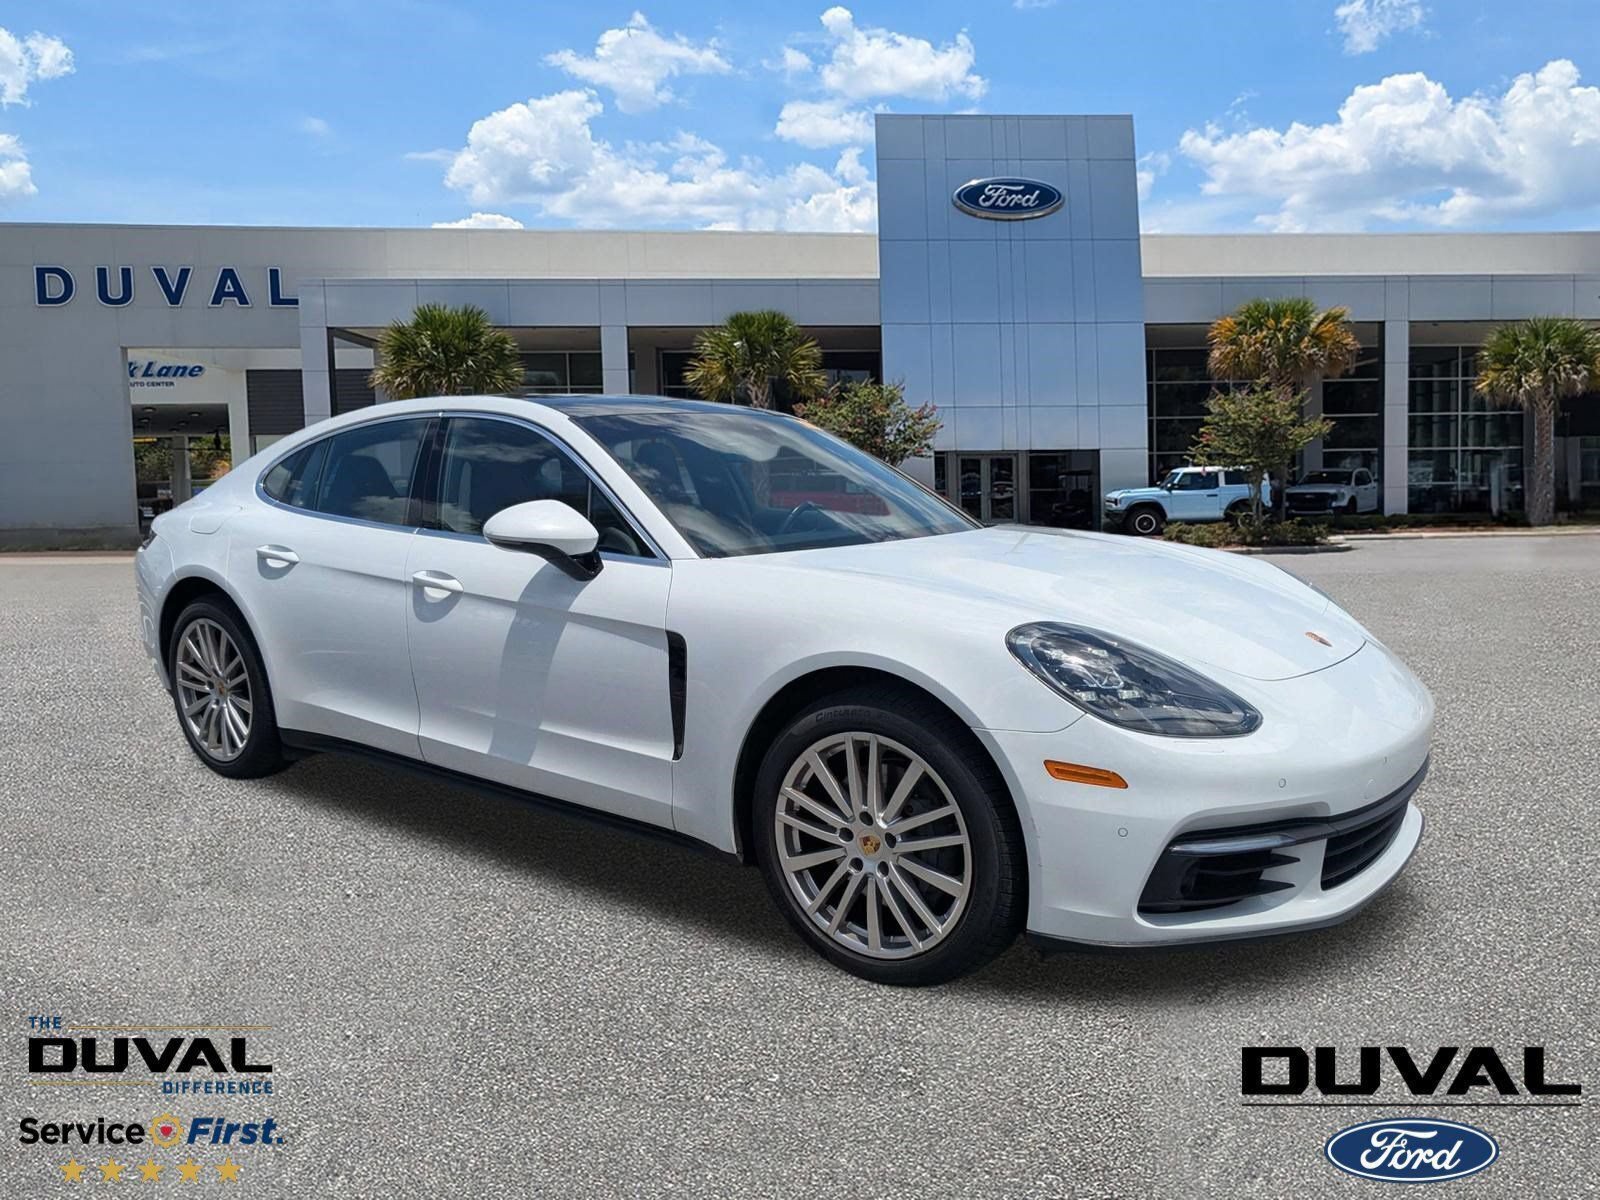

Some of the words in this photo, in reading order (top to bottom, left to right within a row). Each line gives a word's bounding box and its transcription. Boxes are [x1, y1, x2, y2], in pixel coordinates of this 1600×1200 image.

[978, 184, 1041, 208] Ford
[33, 265, 299, 308] DUVAL
[141, 361, 206, 378] Lane
